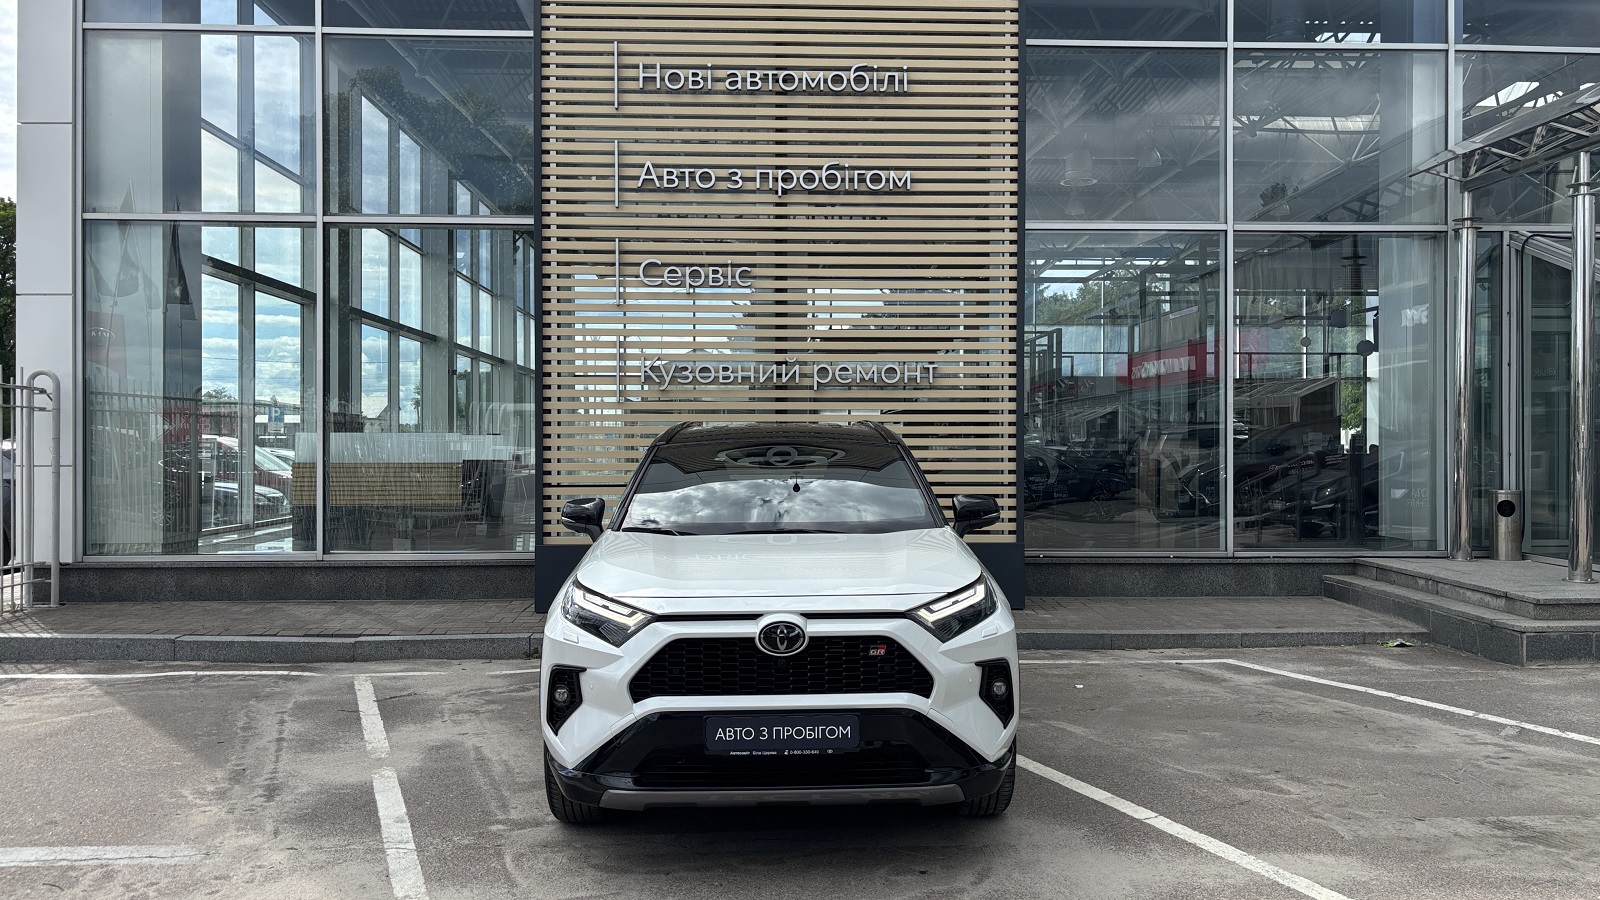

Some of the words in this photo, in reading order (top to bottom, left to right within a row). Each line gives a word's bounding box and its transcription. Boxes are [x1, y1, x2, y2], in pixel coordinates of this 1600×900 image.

[638, 61, 713, 90] Нові
[724, 62, 909, 92] автомобілі
[637, 160, 716, 189] Авто
[726, 167, 744, 190] з
[755, 160, 912, 198] пробігом
[639, 258, 753, 295] Сервіс
[640, 356, 801, 391] Кузовний
[813, 363, 938, 391] ремонт
[715, 727, 755, 741] АВТО
[759, 727, 769, 740] З
[773, 725, 851, 740] ПРОБІГОМ
